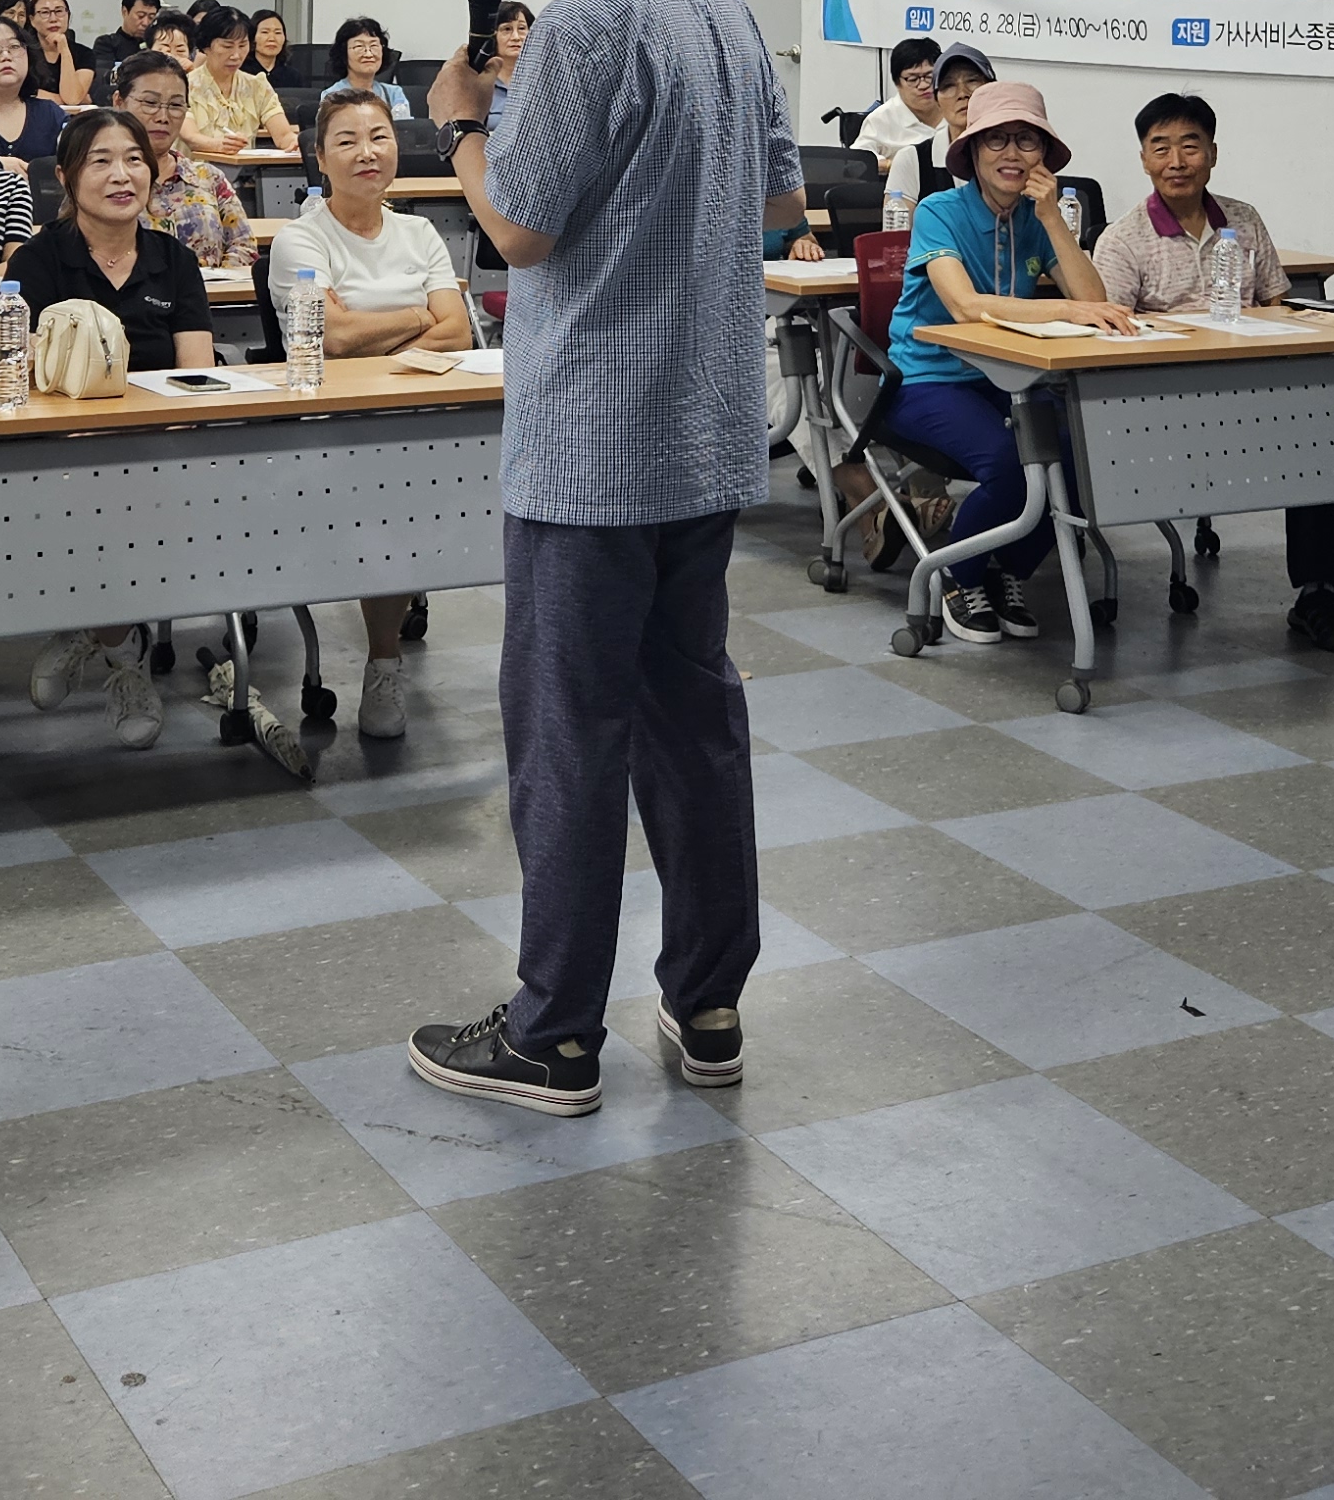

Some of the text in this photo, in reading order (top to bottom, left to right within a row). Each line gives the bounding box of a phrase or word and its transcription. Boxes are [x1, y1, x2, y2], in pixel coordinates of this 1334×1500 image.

[909, 9, 931, 29] 일시
[939, 11, 975, 34] 2026.
[1177, 21, 1206, 43] 지원
